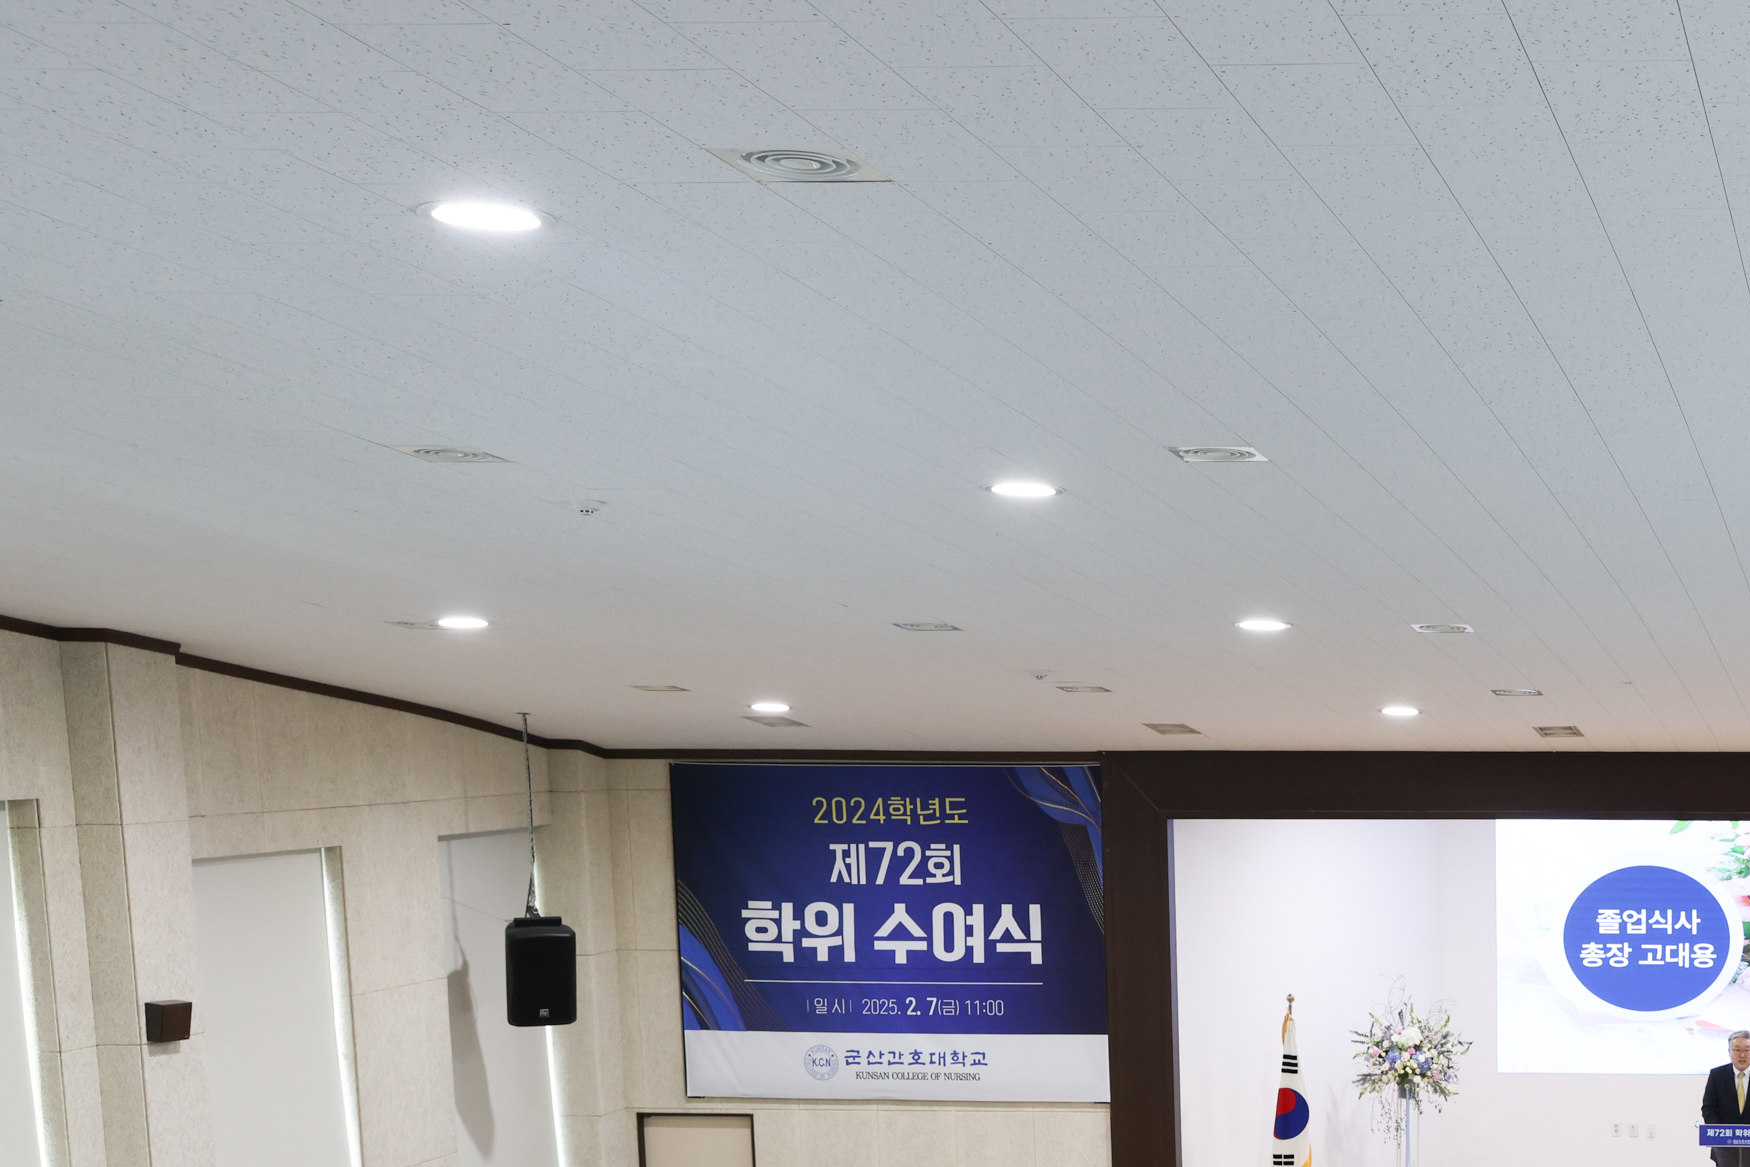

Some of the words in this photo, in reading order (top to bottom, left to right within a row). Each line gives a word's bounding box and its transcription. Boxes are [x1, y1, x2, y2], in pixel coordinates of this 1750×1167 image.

[813, 797, 969, 825] 2024학년도
[829, 841, 962, 886] 제72회
[741, 901, 856, 963] 학위
[874, 903, 1043, 964] 수여식
[1595, 908, 1702, 935] 졸업식사
[1579, 942, 1633, 968] 총장
[1638, 942, 1718, 969] 고대용
[861, 999, 901, 1015] 2025.
[905, 997, 921, 1016] 2.
[926, 997, 960, 1016] 7(금)
[964, 999, 1004, 1015] 11:00
[844, 1049, 989, 1068] 군산간호대학교
[855, 1071, 890, 1080] KUNSAN
[892, 1071, 929, 1081] COLLEGE
[930, 1072, 942, 1081] OF
[943, 1073, 981, 1082] NURSING
[1706, 1128, 1733, 1137] 제72회
